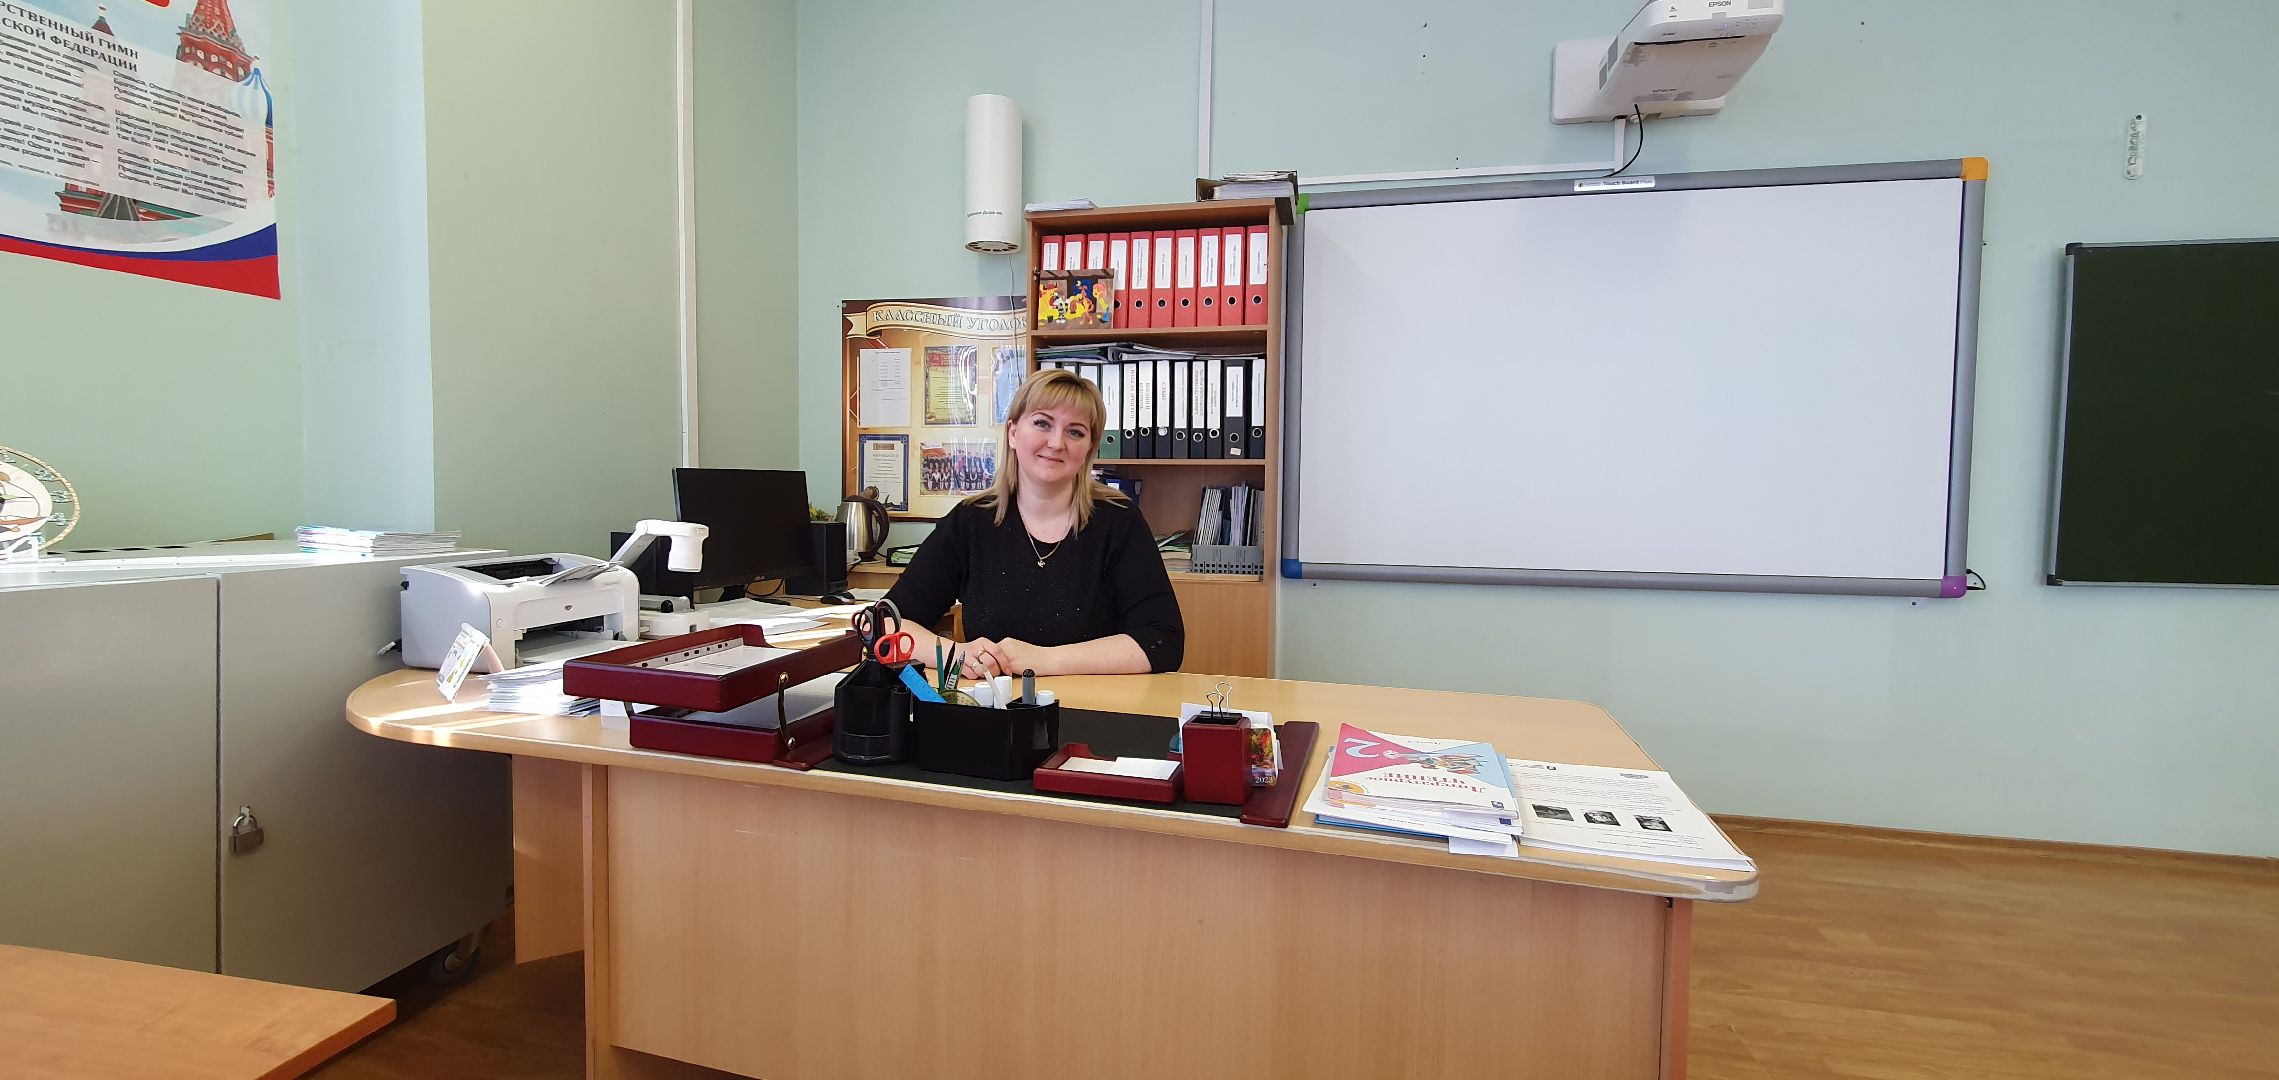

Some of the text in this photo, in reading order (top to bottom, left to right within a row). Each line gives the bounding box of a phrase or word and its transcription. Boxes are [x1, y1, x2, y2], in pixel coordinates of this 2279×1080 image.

[50, 35, 138, 72] ФЕДЕРАЦИИ
[98, 37, 139, 59] ГИМН
[872, 309, 963, 328] КЛАССНЫЙ
